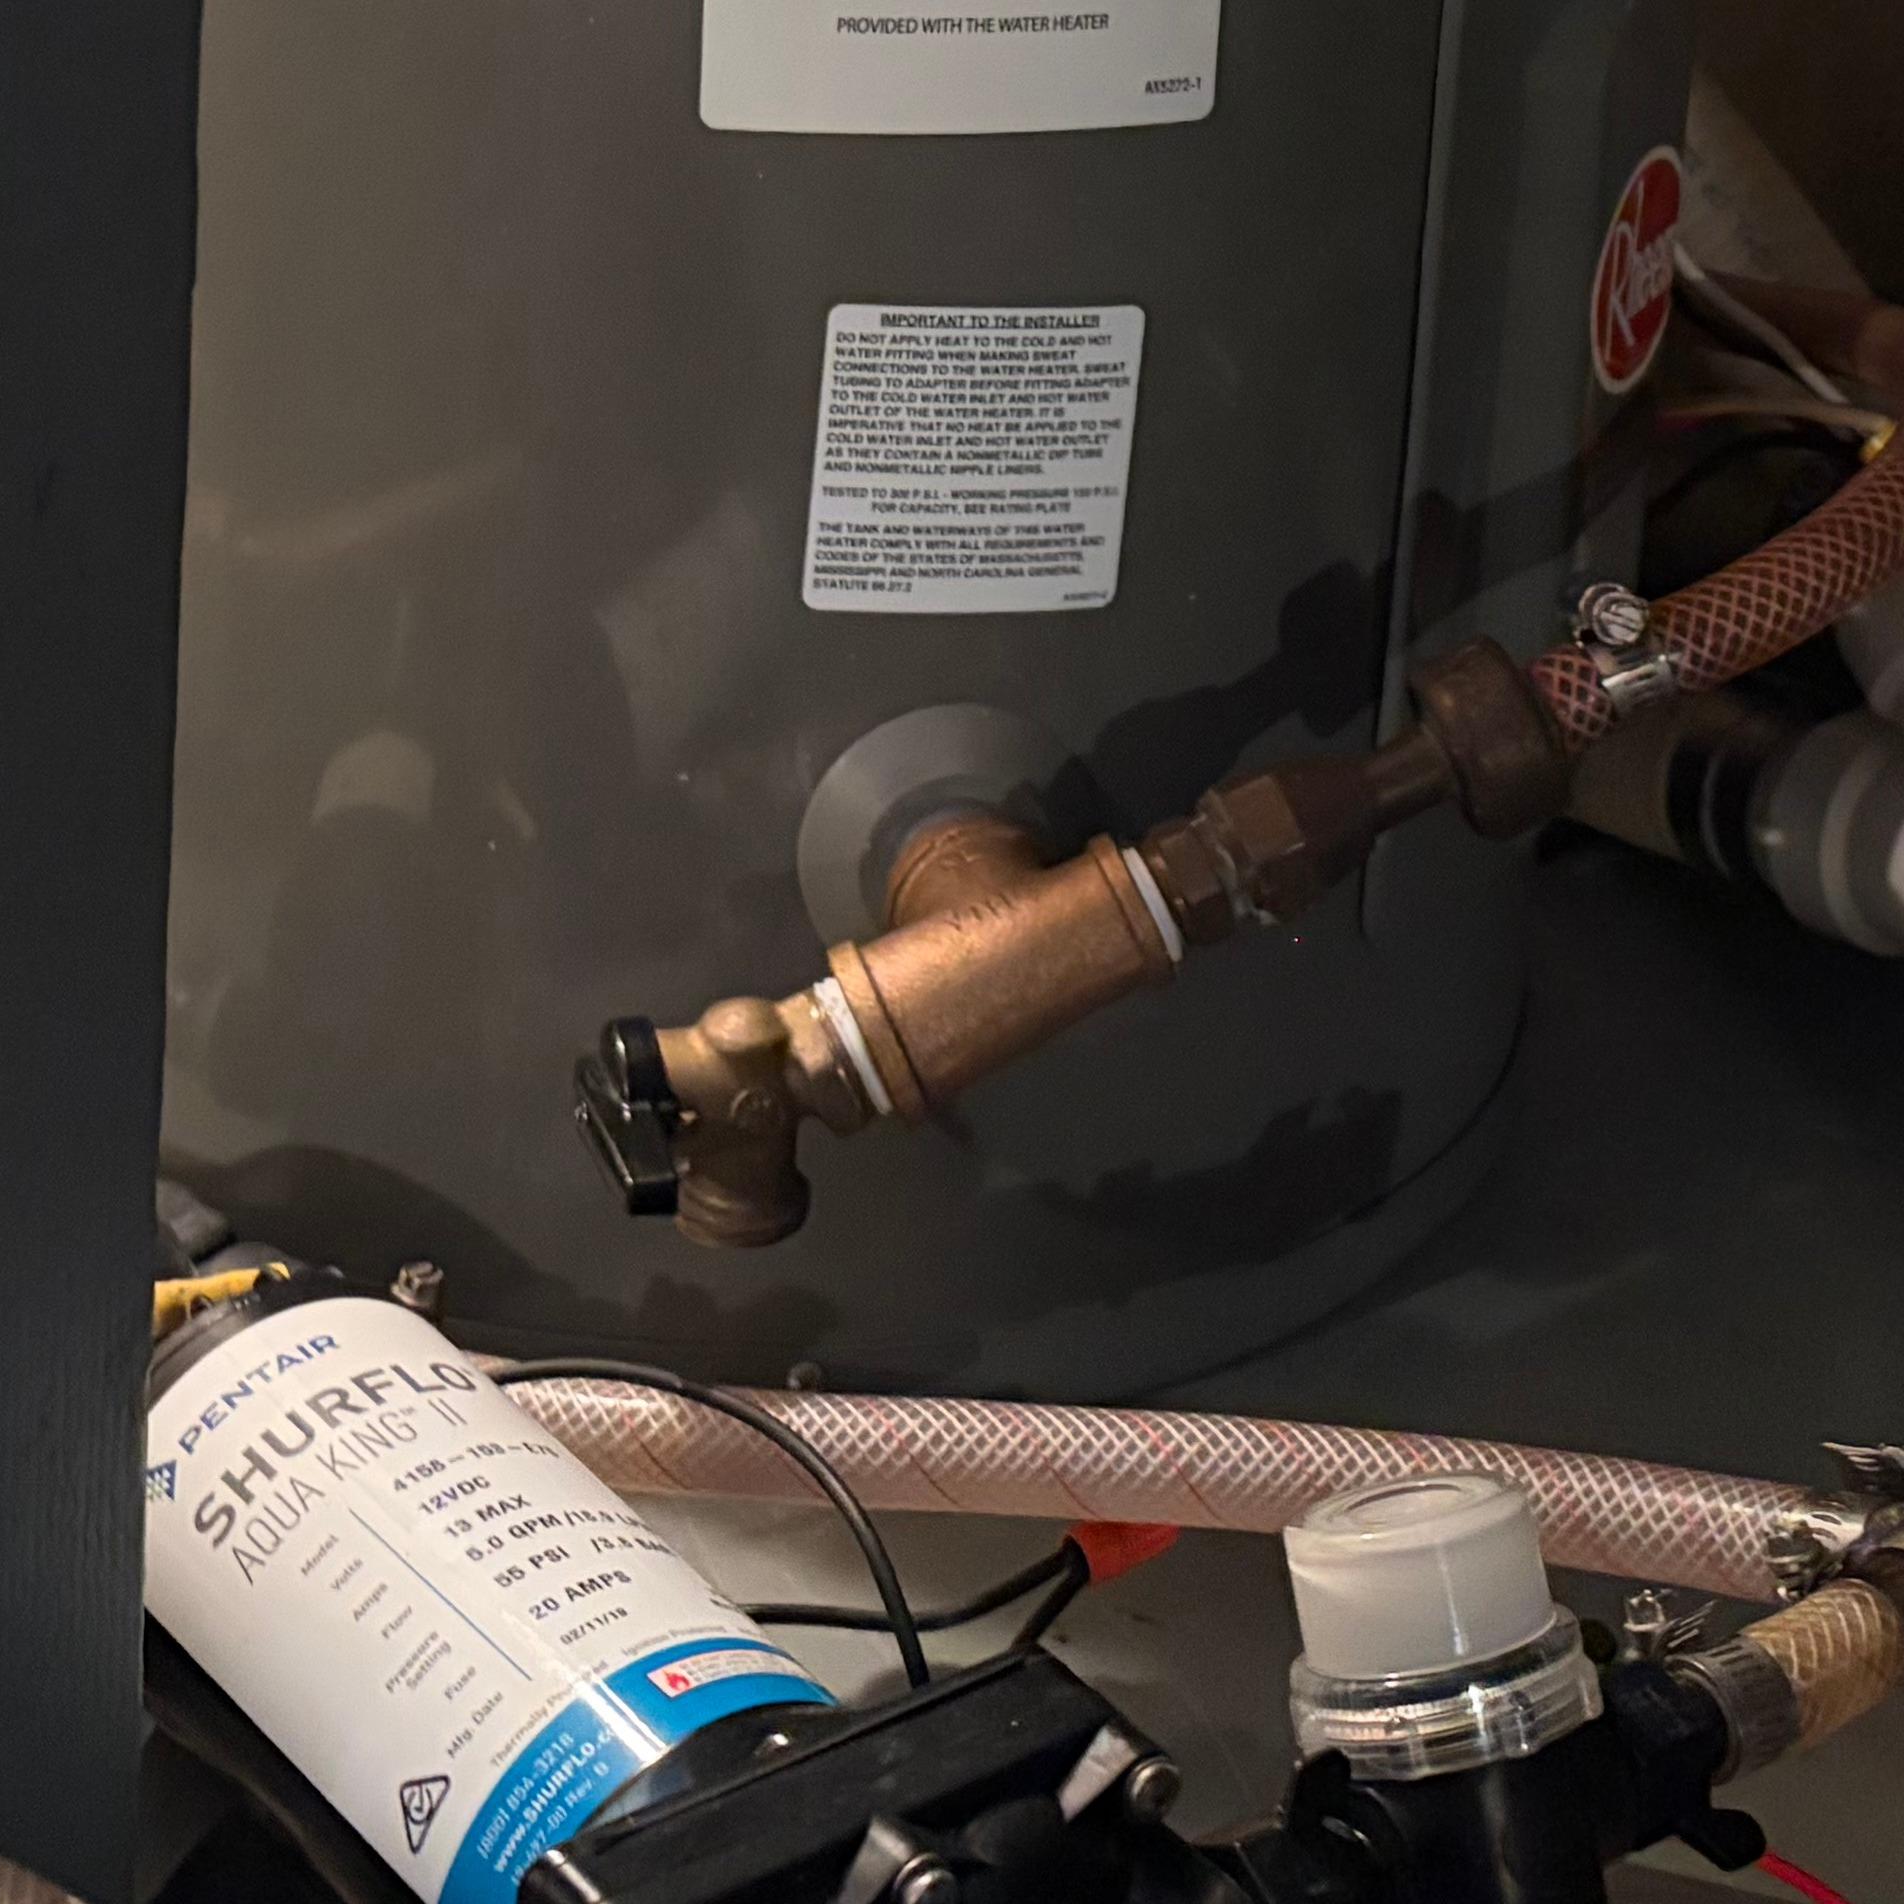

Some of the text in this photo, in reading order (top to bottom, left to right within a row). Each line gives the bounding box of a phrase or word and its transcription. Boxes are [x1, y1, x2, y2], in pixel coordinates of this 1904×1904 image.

[836, 13, 1109, 33] PROVIDED WITH THE WATER HEATER
[880, 314, 1099, 328] IMPORTANT TO THE INSTALLER
[178, 1334, 341, 1455] PENTAIR
[194, 1362, 476, 1548] SHURFLO
[231, 1476, 326, 1586] AQUA
[301, 1534, 339, 1576] Model
[330, 1475, 491, 1591] Volts 12VDC
[353, 1493, 531, 1622] Amps 13 MAX
[381, 1605, 413, 1639] Flow
[386, 1631, 439, 1693] Pressure
[405, 1641, 452, 1690] Setting
[493, 1565, 526, 1588] 55
[528, 1545, 571, 1571] PSI
[444, 1569, 632, 1700] Fuse 20 AMPS
[471, 1692, 504, 1726] Date
